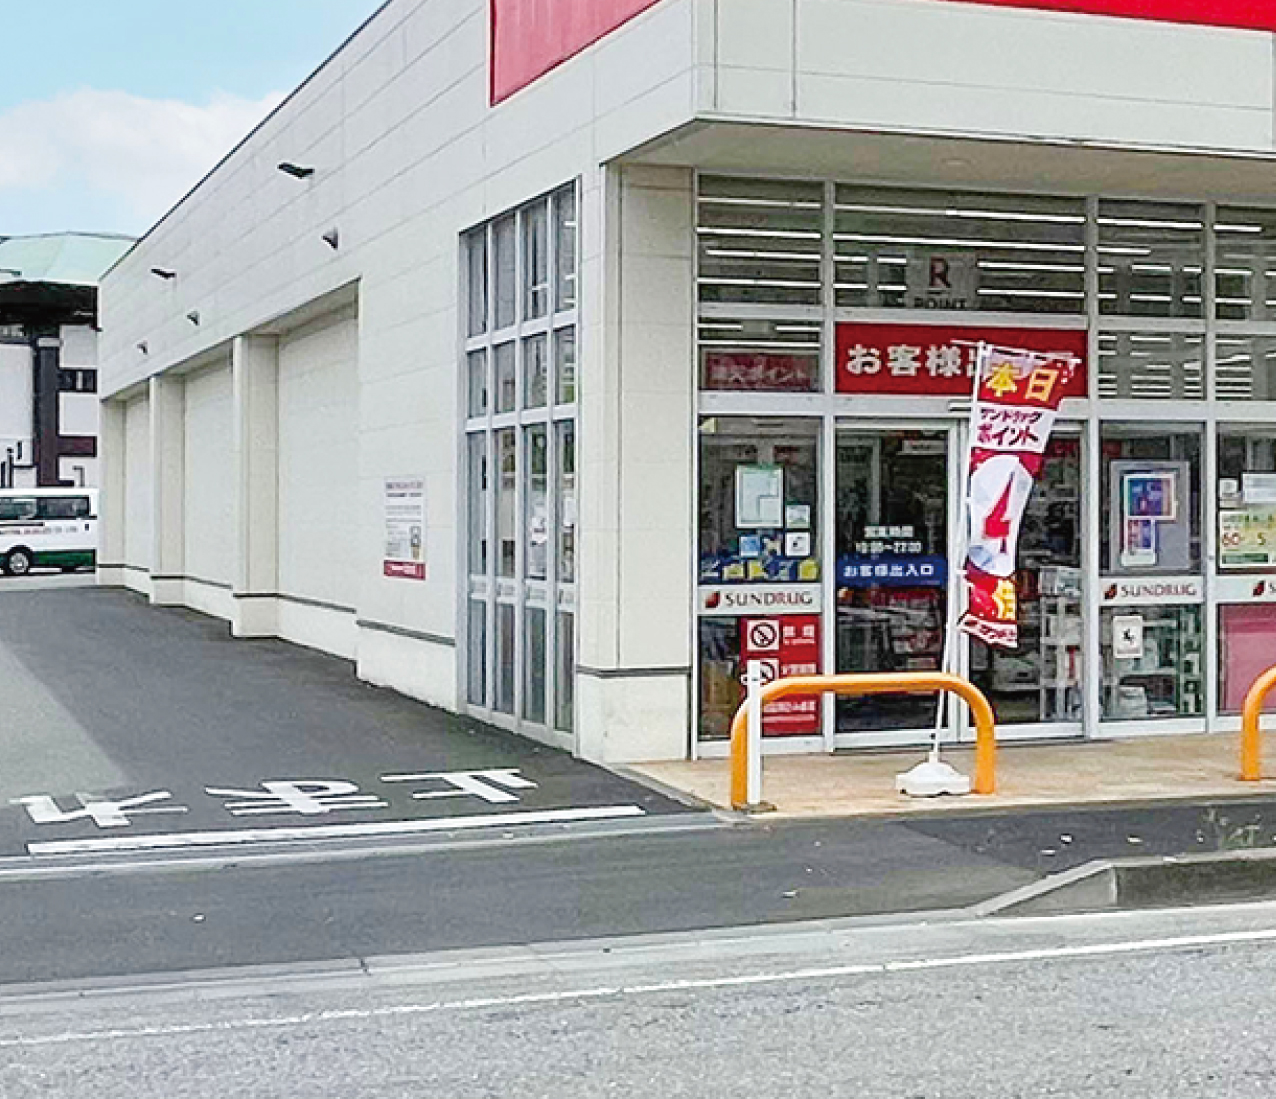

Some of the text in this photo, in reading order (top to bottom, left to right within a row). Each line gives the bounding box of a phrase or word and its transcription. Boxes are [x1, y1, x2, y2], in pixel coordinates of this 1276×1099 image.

[846, 343, 977, 378] お客様
[985, 362, 1060, 402] 本日
[977, 423, 1040, 447] ポイント
[725, 591, 813, 607] SUNDRUG
[1120, 582, 1198, 598] SUNDRUG
